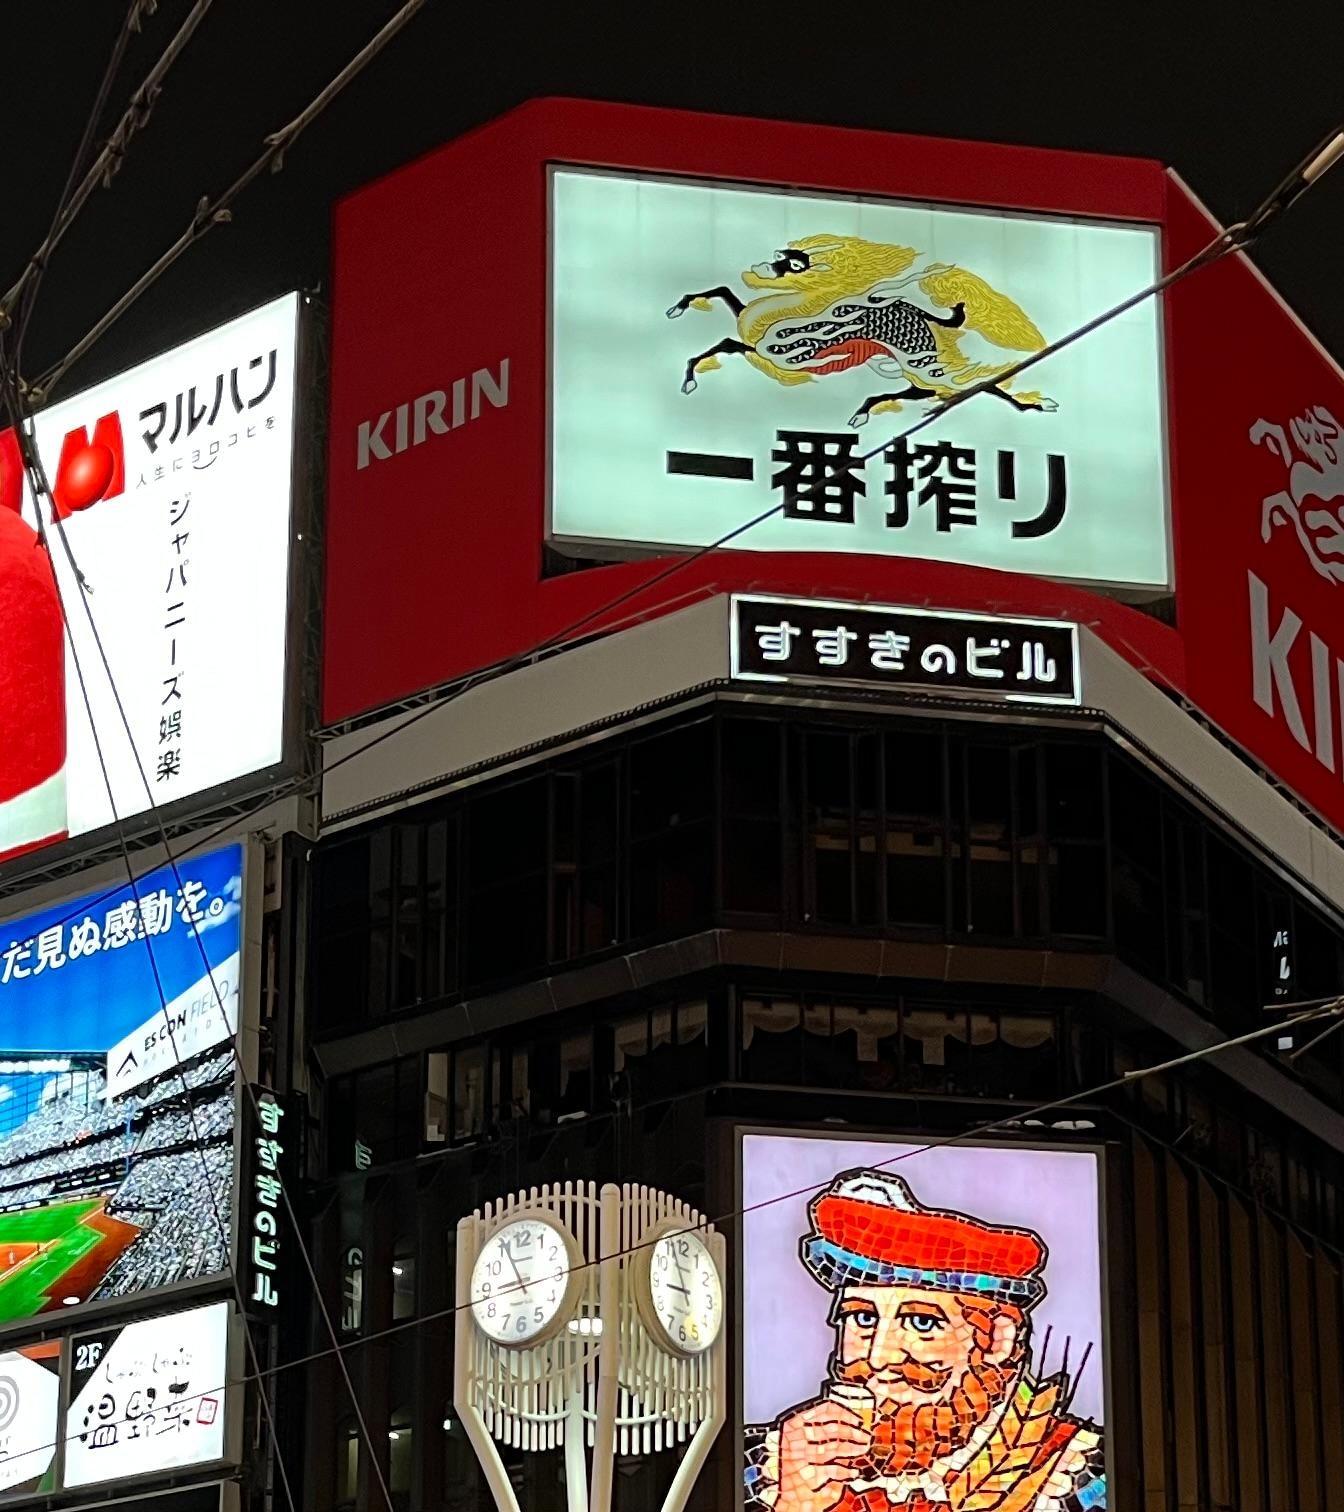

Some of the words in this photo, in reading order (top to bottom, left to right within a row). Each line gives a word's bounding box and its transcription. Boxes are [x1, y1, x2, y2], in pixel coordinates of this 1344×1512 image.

[139, 349, 277, 454] マルハン
[355, 358, 511, 472] KIRIN
[665, 429, 1068, 539] 一番搾り
[156, 491, 192, 783] ジャパニーズ娯楽
[755, 620, 1056, 683] すすきのビル
[143, 1008, 187, 1051] ESCON
[252, 1101, 284, 1307] すすきのビル
[514, 1229, 532, 1248] 12
[676, 1239, 689, 1258] 12
[75, 1343, 103, 1371] 2F
